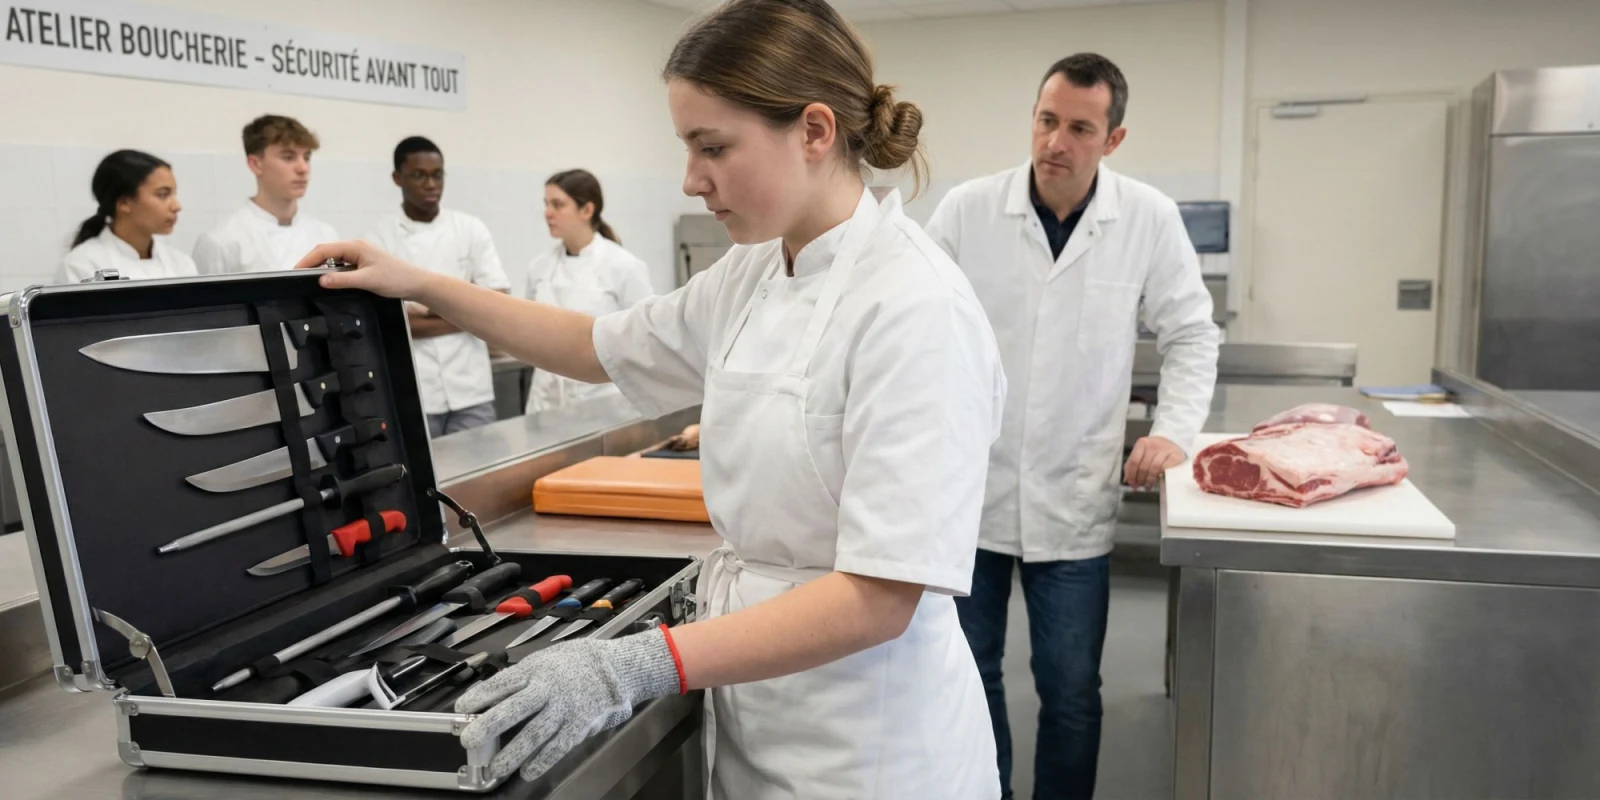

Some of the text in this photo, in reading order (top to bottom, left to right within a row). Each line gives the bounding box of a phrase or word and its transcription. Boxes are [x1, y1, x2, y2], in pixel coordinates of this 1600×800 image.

[6, 7, 112, 53] ATELIER
[119, 22, 248, 69] BOUCHERIE
[271, 39, 361, 83] SÉCURITÉ
[365, 58, 417, 90] AVANT
[421, 64, 459, 94] TOUT
